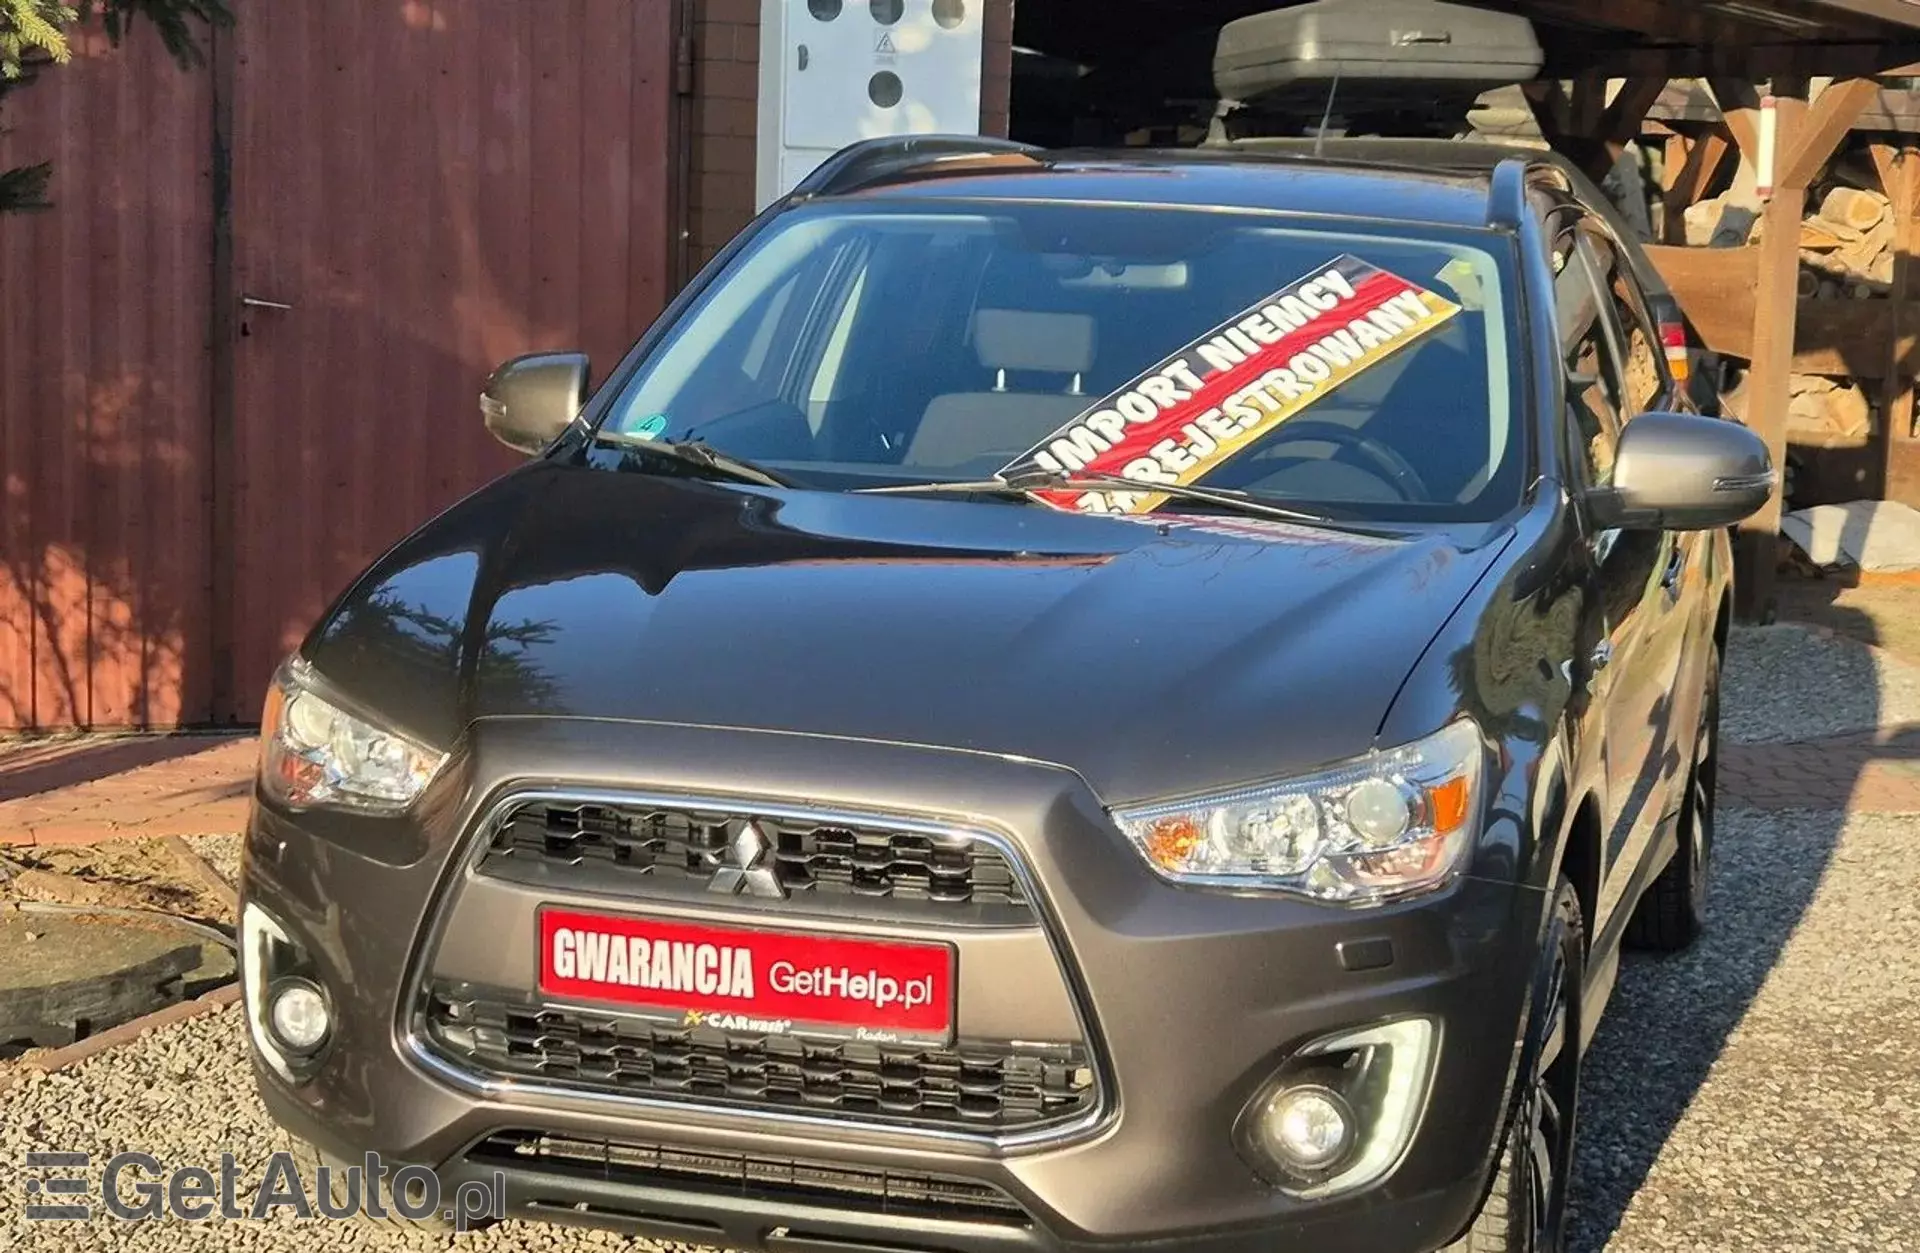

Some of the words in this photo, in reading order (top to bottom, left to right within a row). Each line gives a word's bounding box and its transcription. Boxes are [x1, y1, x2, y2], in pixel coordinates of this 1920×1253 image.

[1034, 358, 1206, 473] IMPORT
[1196, 269, 1357, 373] NIEMCY
[553, 928, 755, 998] GWARANCJA
[769, 961, 933, 1010] GetHelp.pl
